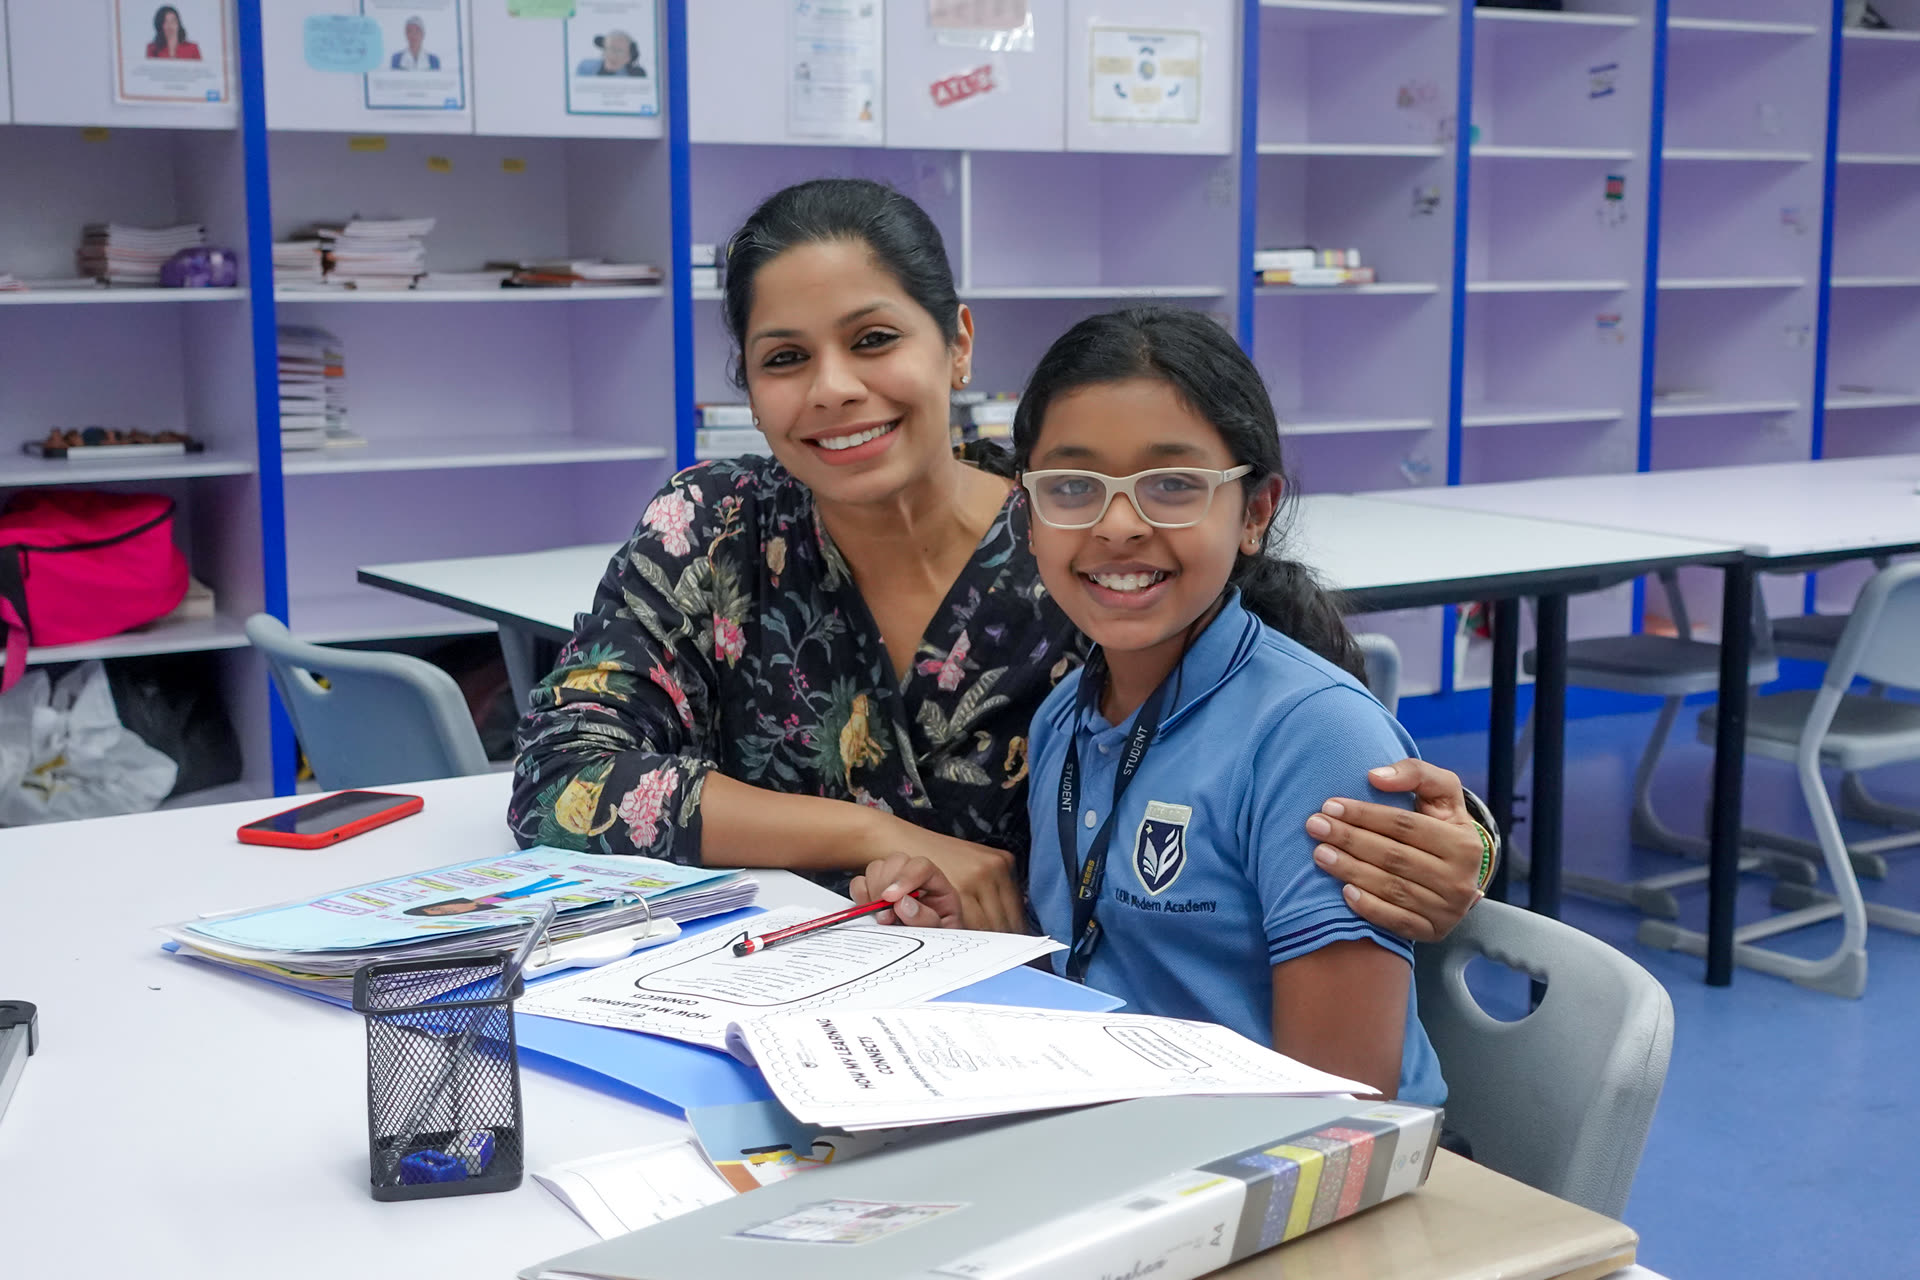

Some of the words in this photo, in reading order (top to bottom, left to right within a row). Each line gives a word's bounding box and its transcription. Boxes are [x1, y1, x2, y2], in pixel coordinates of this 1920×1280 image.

[1123, 725, 1148, 775] STUDENT
[1062, 763, 1073, 812] STUDENT
[1163, 899, 1217, 913] Academy
[577, 996, 650, 1010] LEARNING
[631, 993, 699, 1006] CONNECTS
[649, 1005, 673, 1013] MY
[672, 1010, 712, 1020] HOW
[816, 1018, 852, 1056] LEARNING
[857, 1036, 894, 1075] CONNECTS
[840, 1057, 861, 1070] MY
[848, 1071, 876, 1089] HOW
